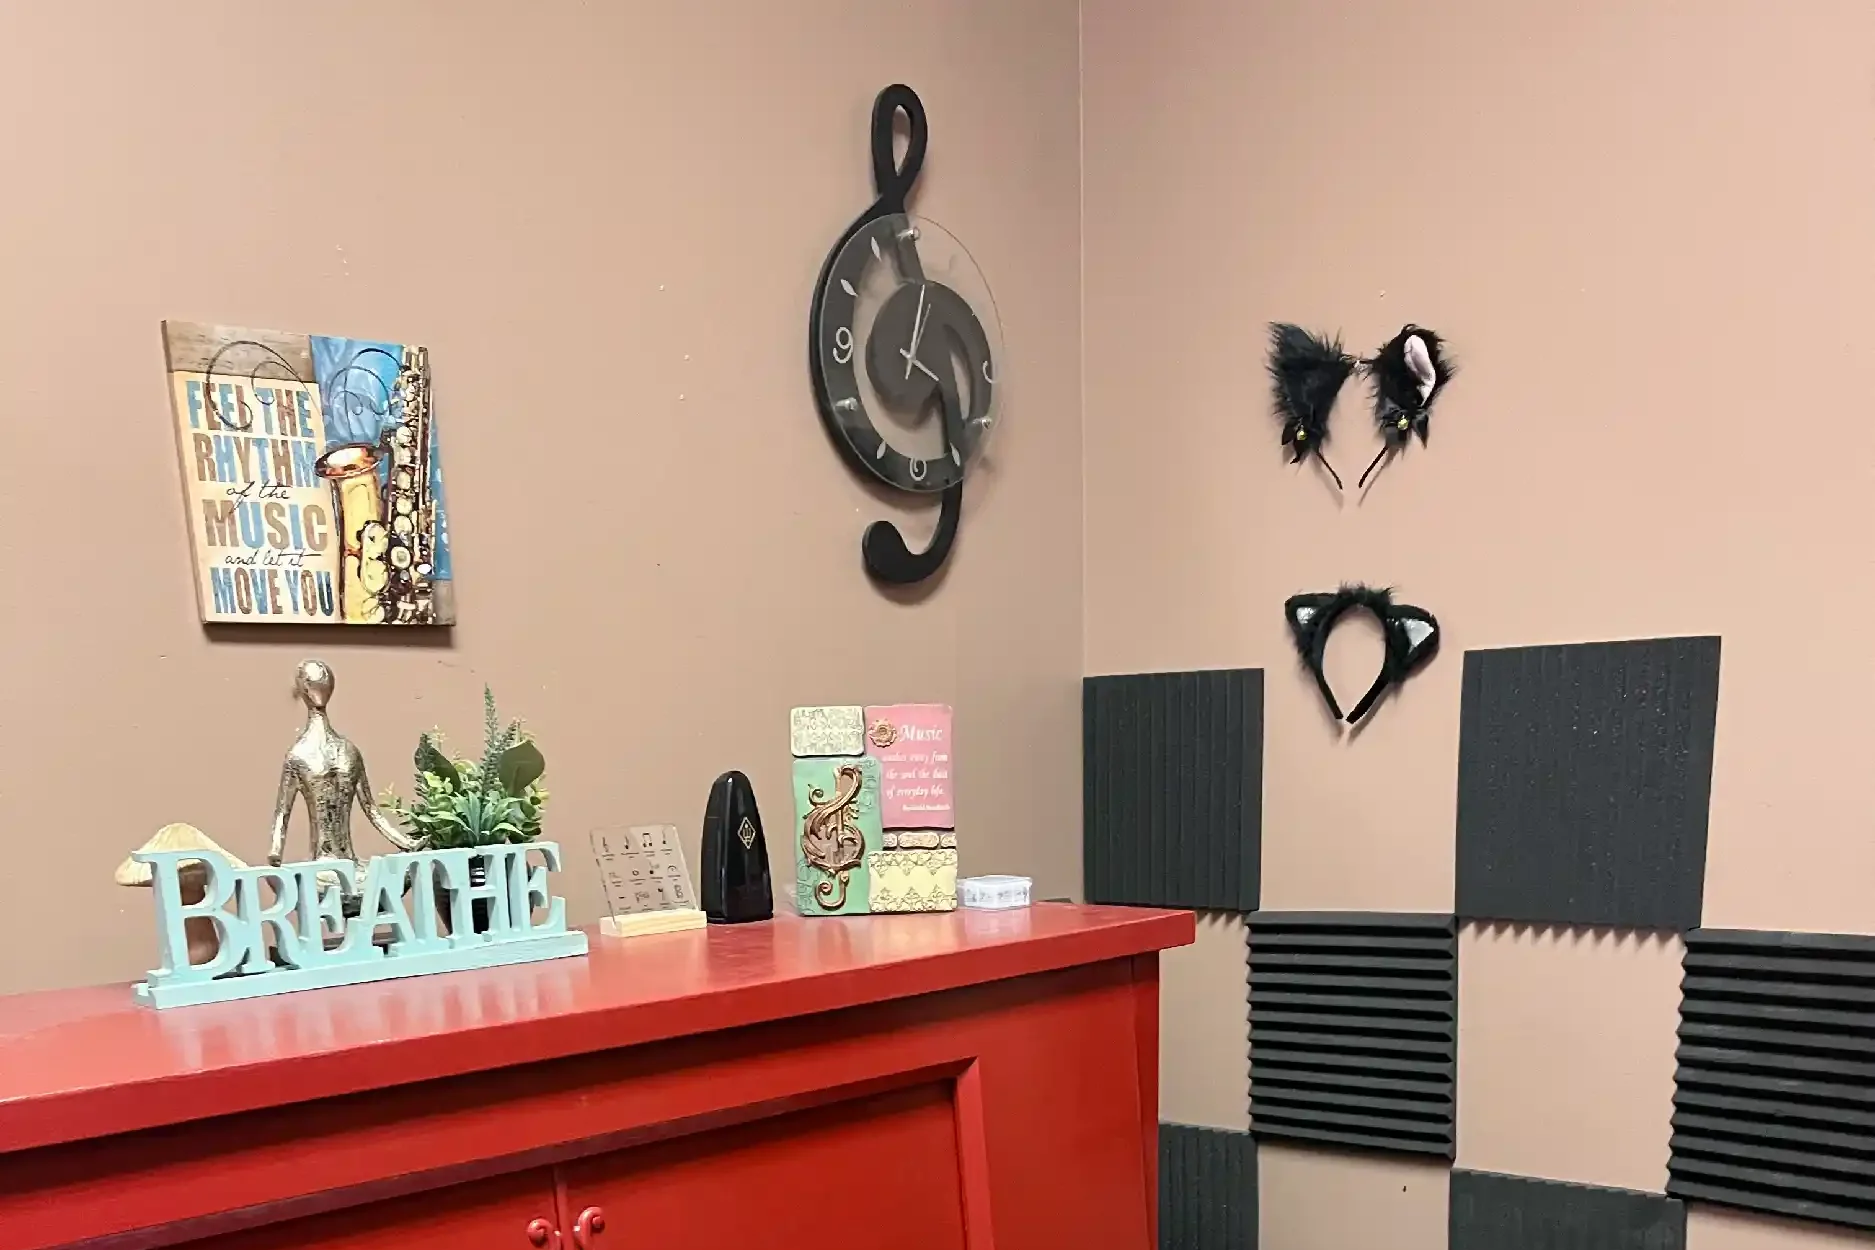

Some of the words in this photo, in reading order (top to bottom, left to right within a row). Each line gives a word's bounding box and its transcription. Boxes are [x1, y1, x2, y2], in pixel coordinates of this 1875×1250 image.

[832, 326, 854, 363] 9
[256, 387, 315, 438] THE
[192, 432, 320, 488] RHYTHM
[226, 480, 255, 515] of
[258, 479, 293, 500] the
[202, 498, 328, 551] MUSIC
[225, 549, 258, 565] and
[262, 549, 284, 566] let
[210, 566, 283, 615] MOVE
[284, 569, 334, 617] YOU
[899, 723, 943, 742] Music
[132, 841, 566, 980] BREATHE
